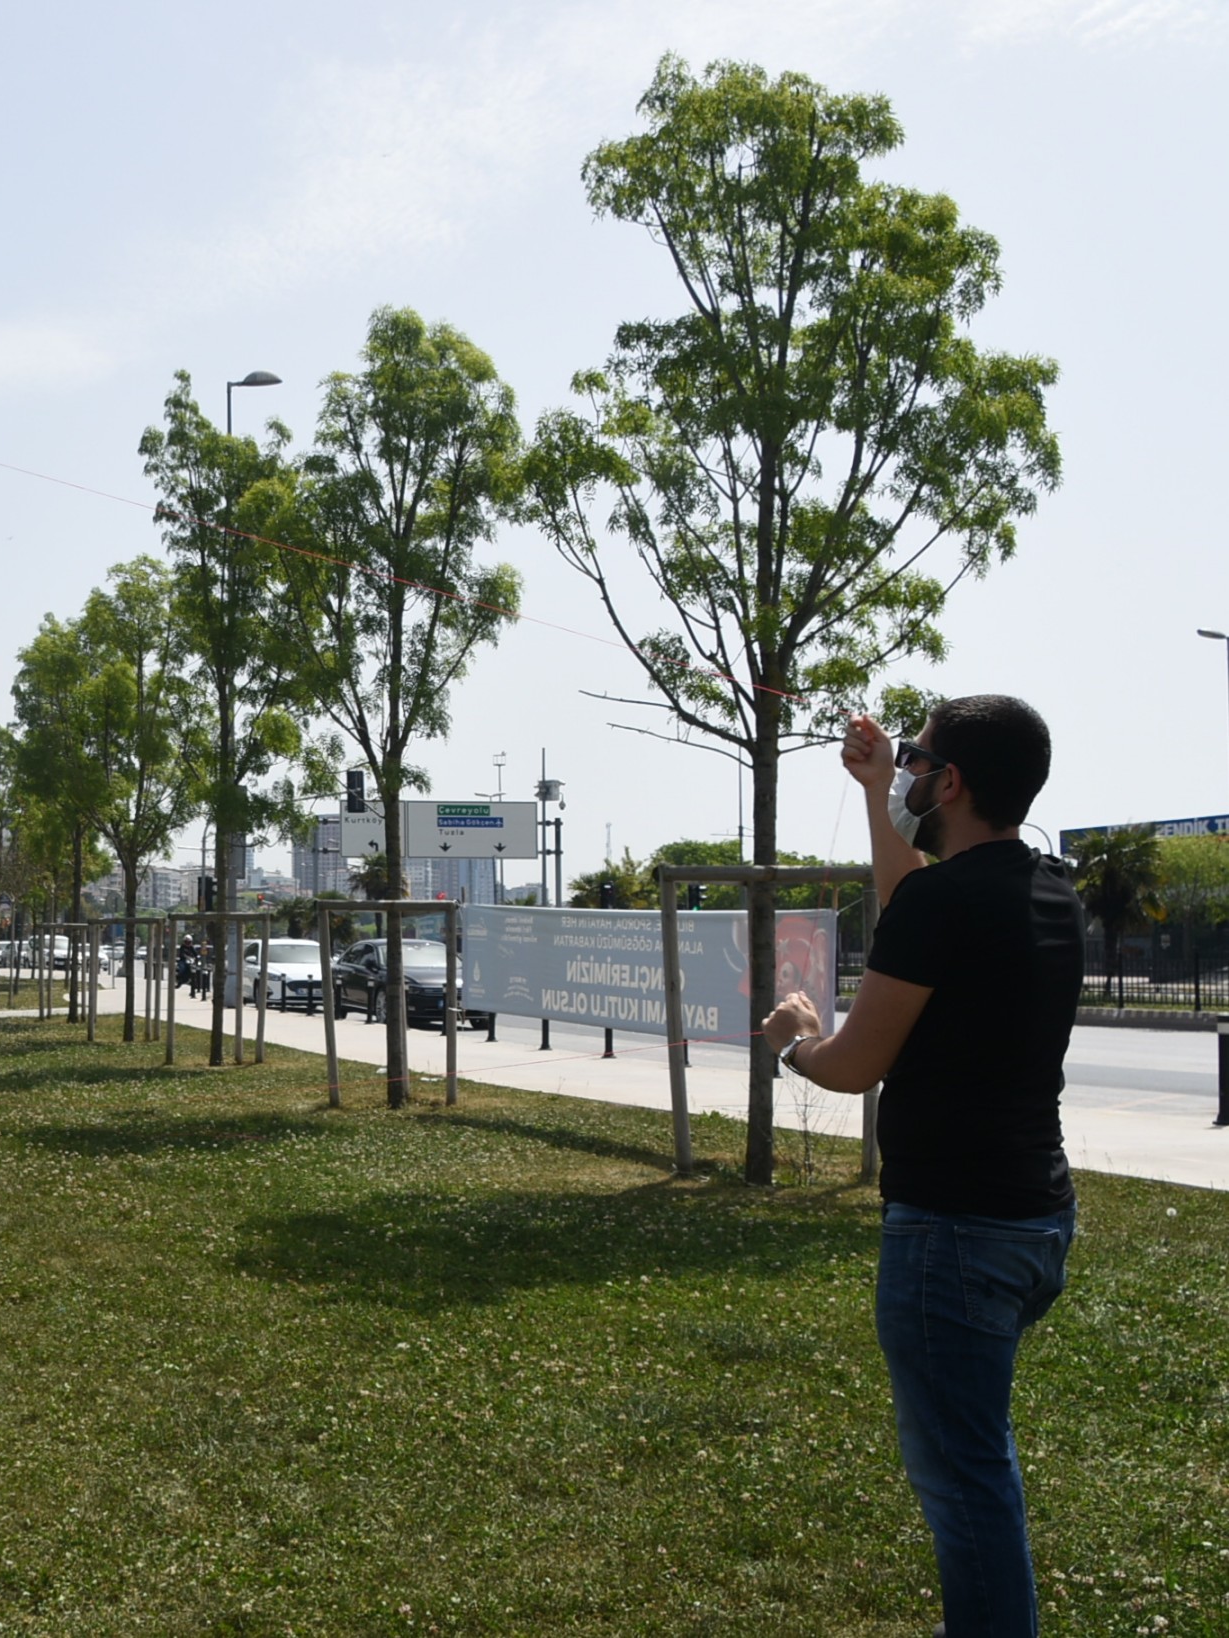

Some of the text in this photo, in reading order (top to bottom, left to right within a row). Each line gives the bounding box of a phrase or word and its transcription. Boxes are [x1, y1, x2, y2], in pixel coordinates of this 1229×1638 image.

[344, 816, 383, 826] Kurtköy
[438, 818, 496, 827] Sabiha Gökçen
[439, 828, 465, 836] Tuzla
